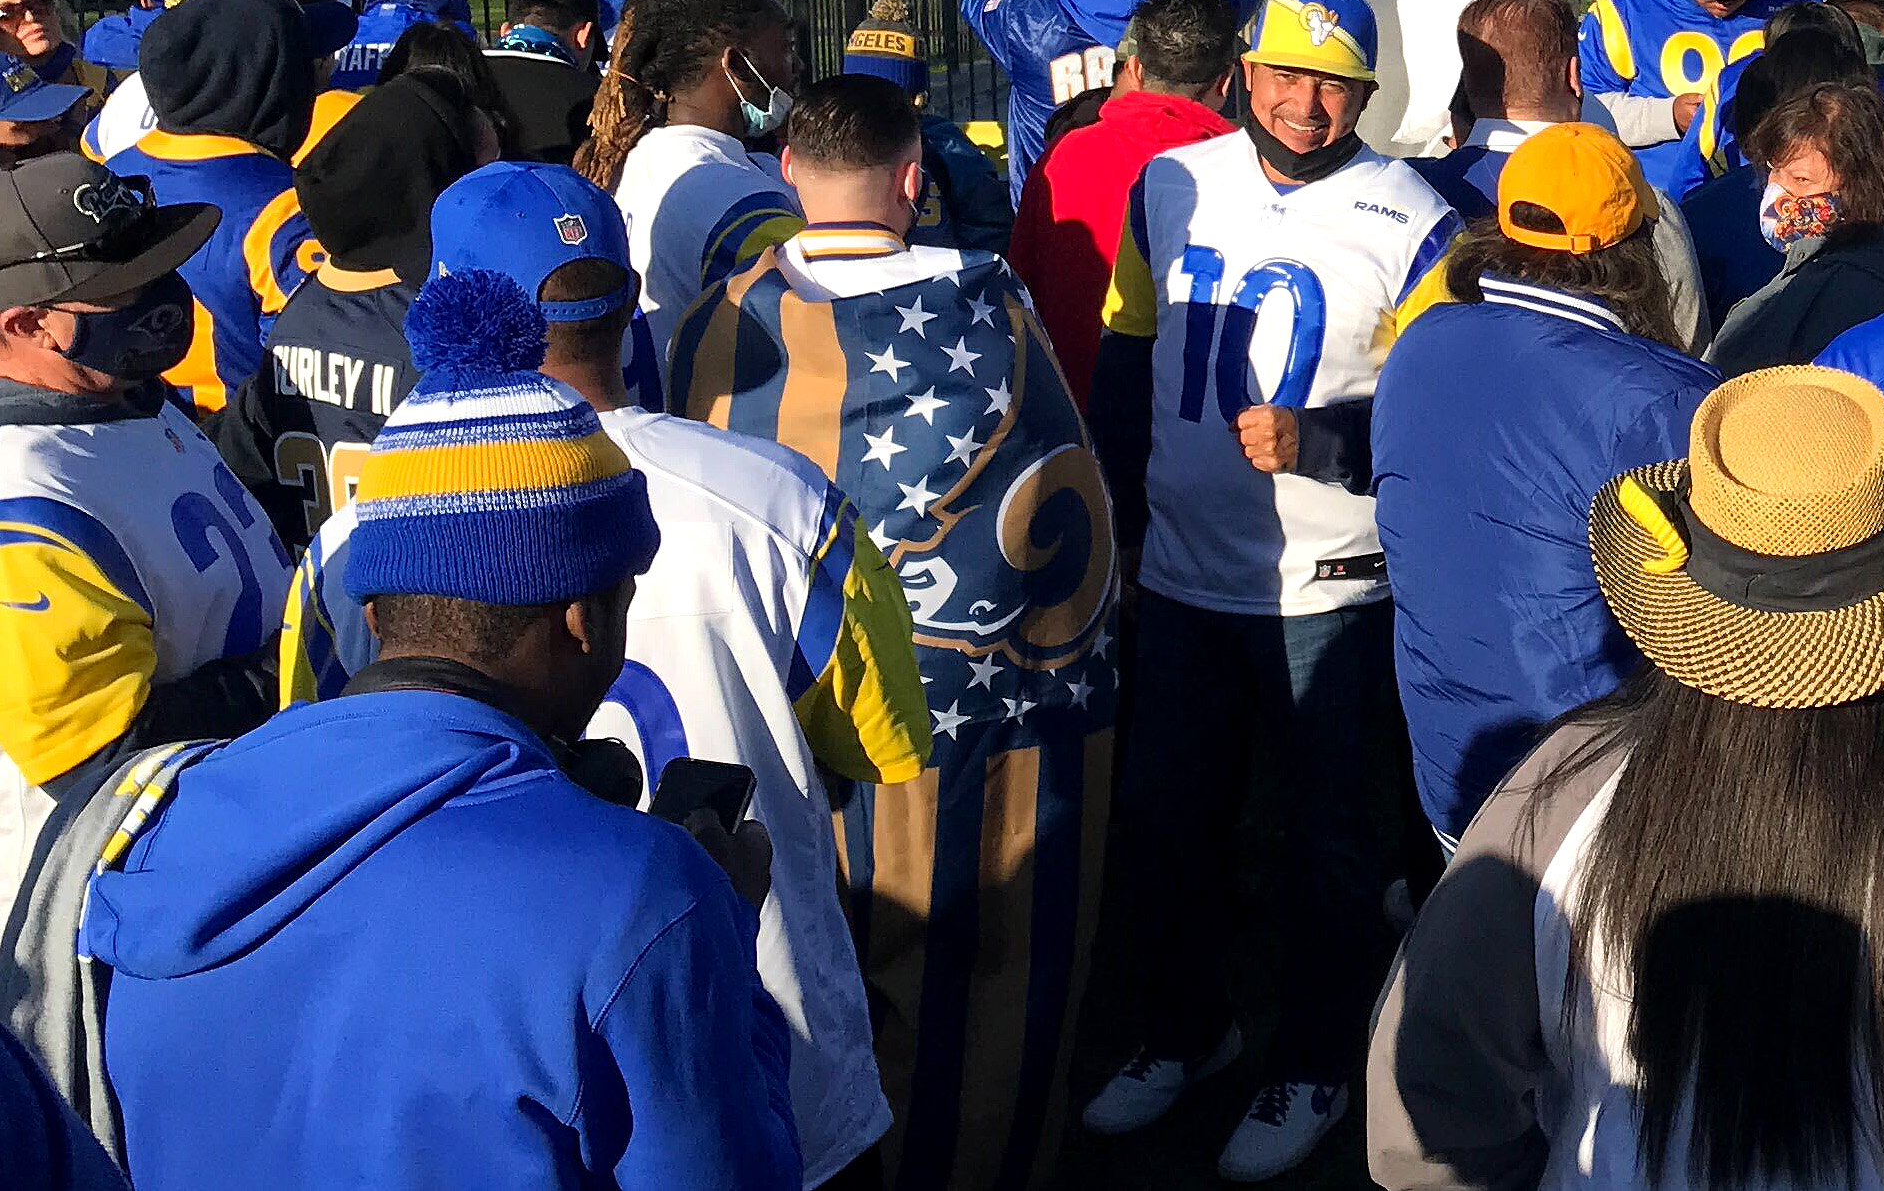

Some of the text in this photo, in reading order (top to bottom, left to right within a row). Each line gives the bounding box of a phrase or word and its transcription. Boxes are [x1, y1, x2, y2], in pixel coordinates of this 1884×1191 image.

[1353, 201, 1410, 225] RAMS
[1179, 244, 1327, 425] 10
[370, 363, 394, 417] II
